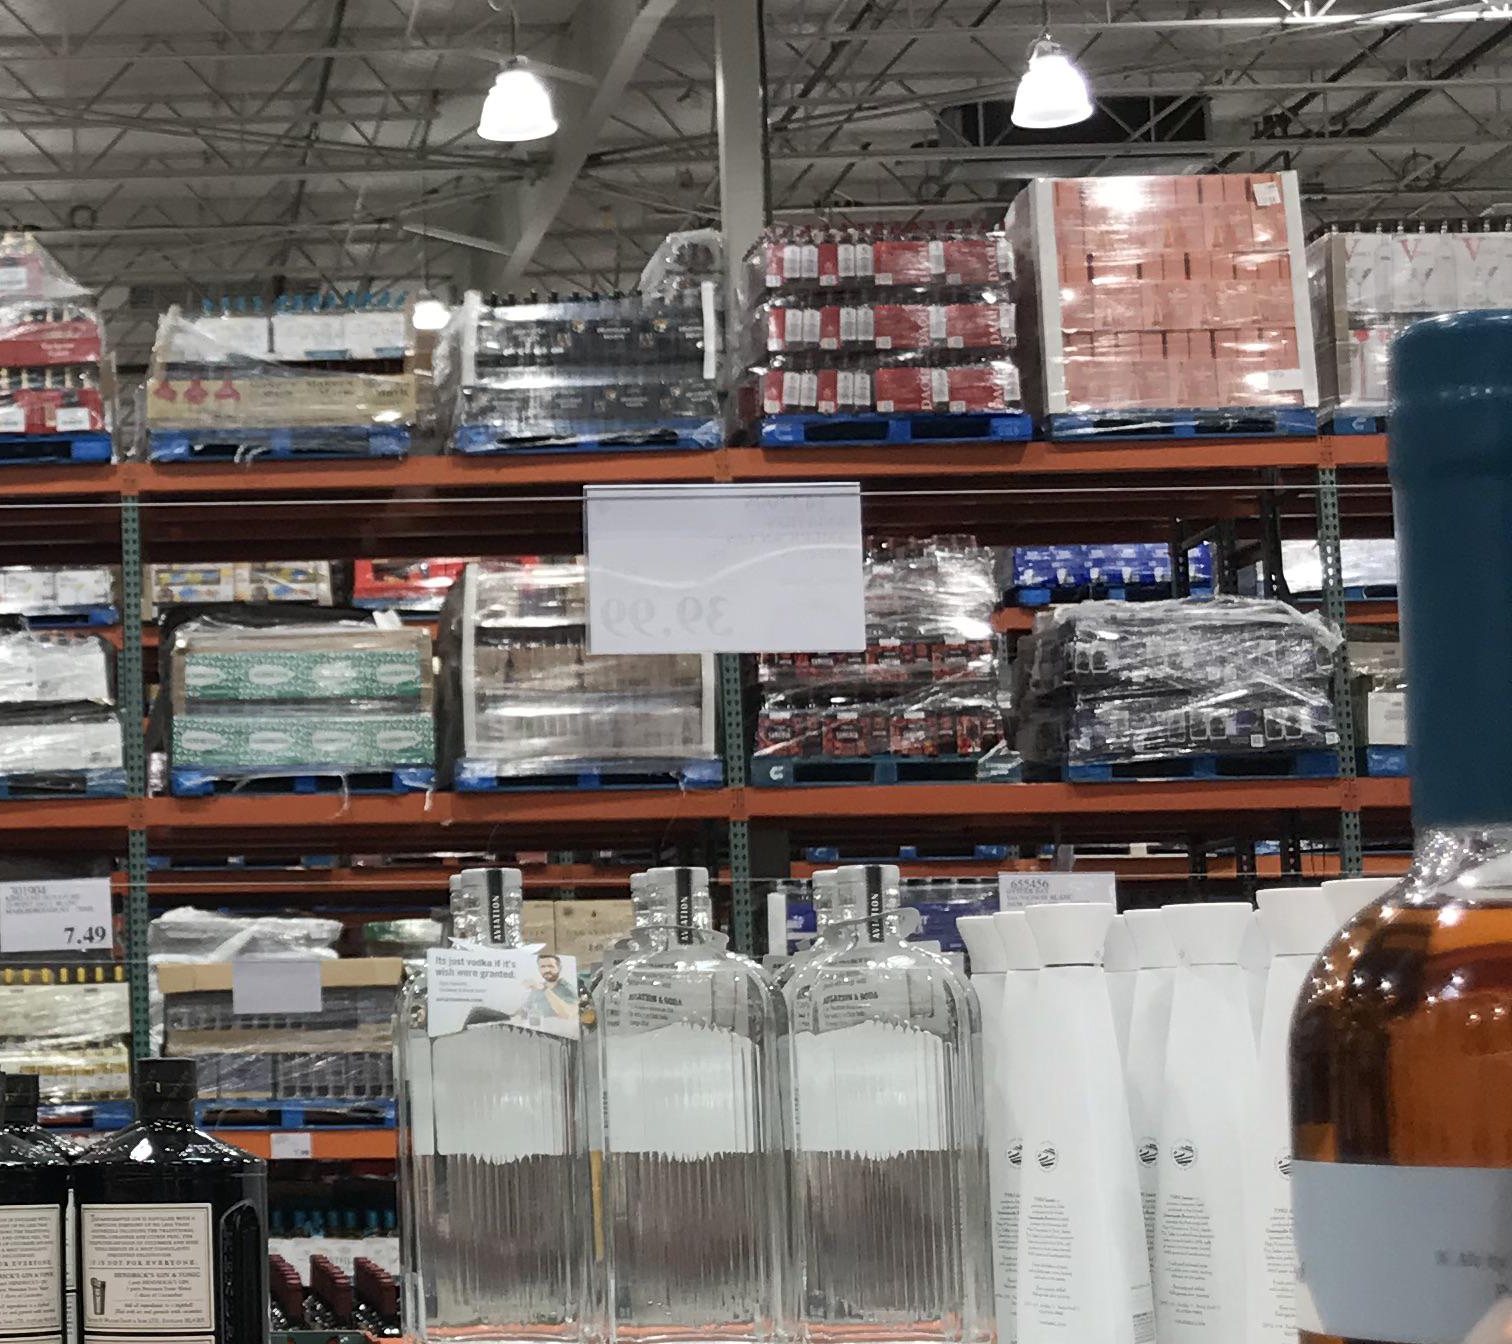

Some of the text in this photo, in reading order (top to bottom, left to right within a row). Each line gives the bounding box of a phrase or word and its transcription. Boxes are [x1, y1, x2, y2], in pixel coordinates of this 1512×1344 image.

[492, 895, 502, 941] AVIATION
[679, 896, 689, 941] AVATION
[63, 925, 106, 944] 7.49
[467, 957, 493, 967] vodka
